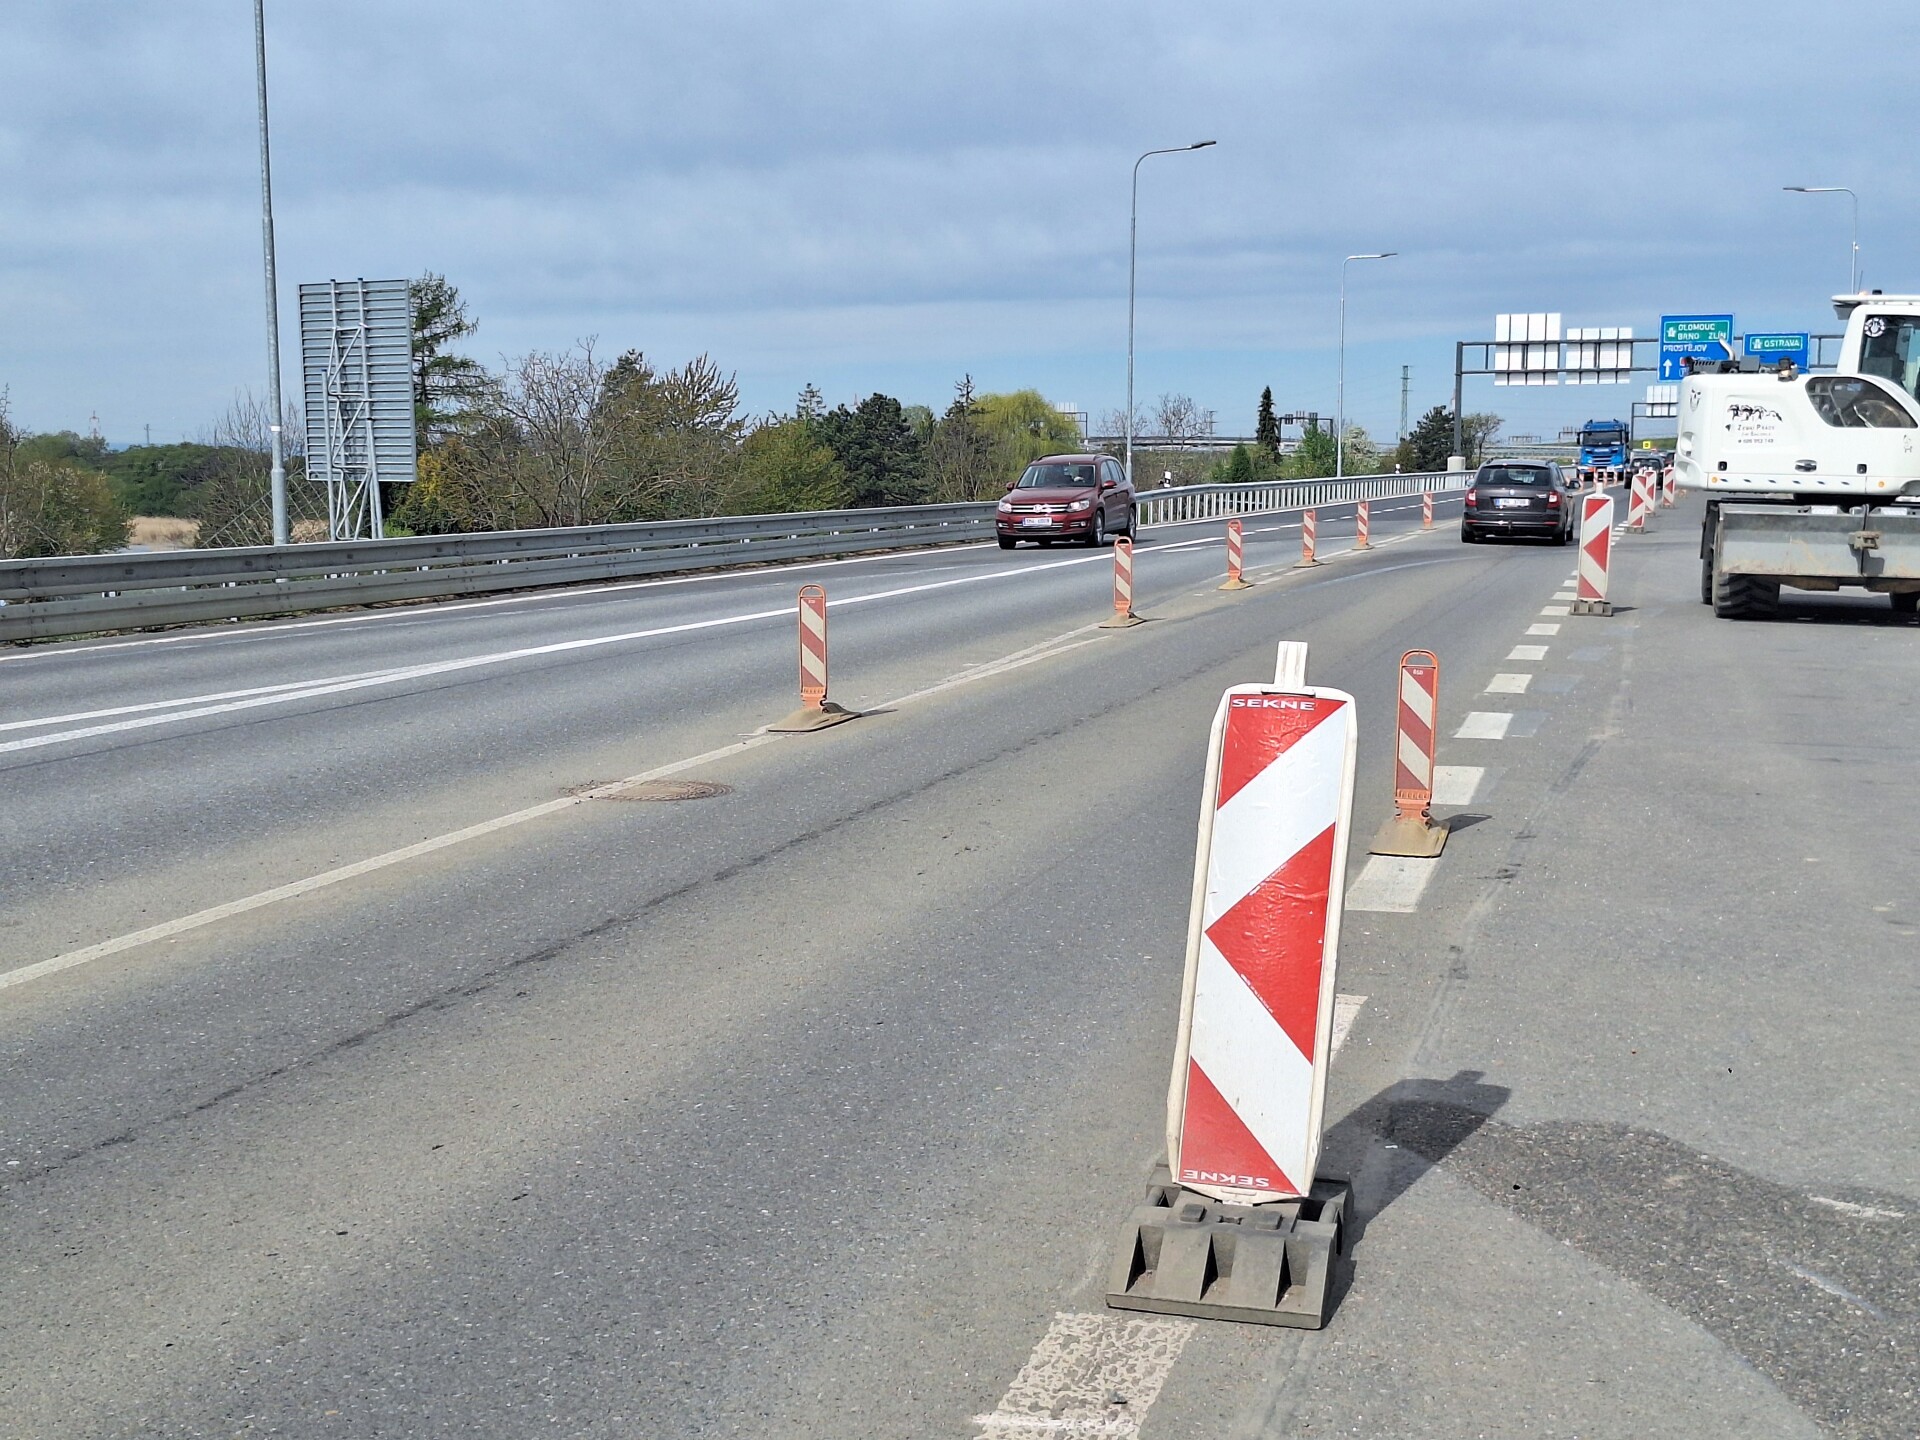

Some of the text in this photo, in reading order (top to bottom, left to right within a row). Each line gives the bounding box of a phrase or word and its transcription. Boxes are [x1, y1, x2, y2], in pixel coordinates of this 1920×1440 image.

[1678, 323, 1715, 331] OLOMOUC
[1677, 331, 1699, 340] BRNO
[1764, 339, 1800, 347] OSTRAVA
[1231, 698, 1316, 711] SEKNE
[1183, 1169, 1270, 1188] SEKNE
